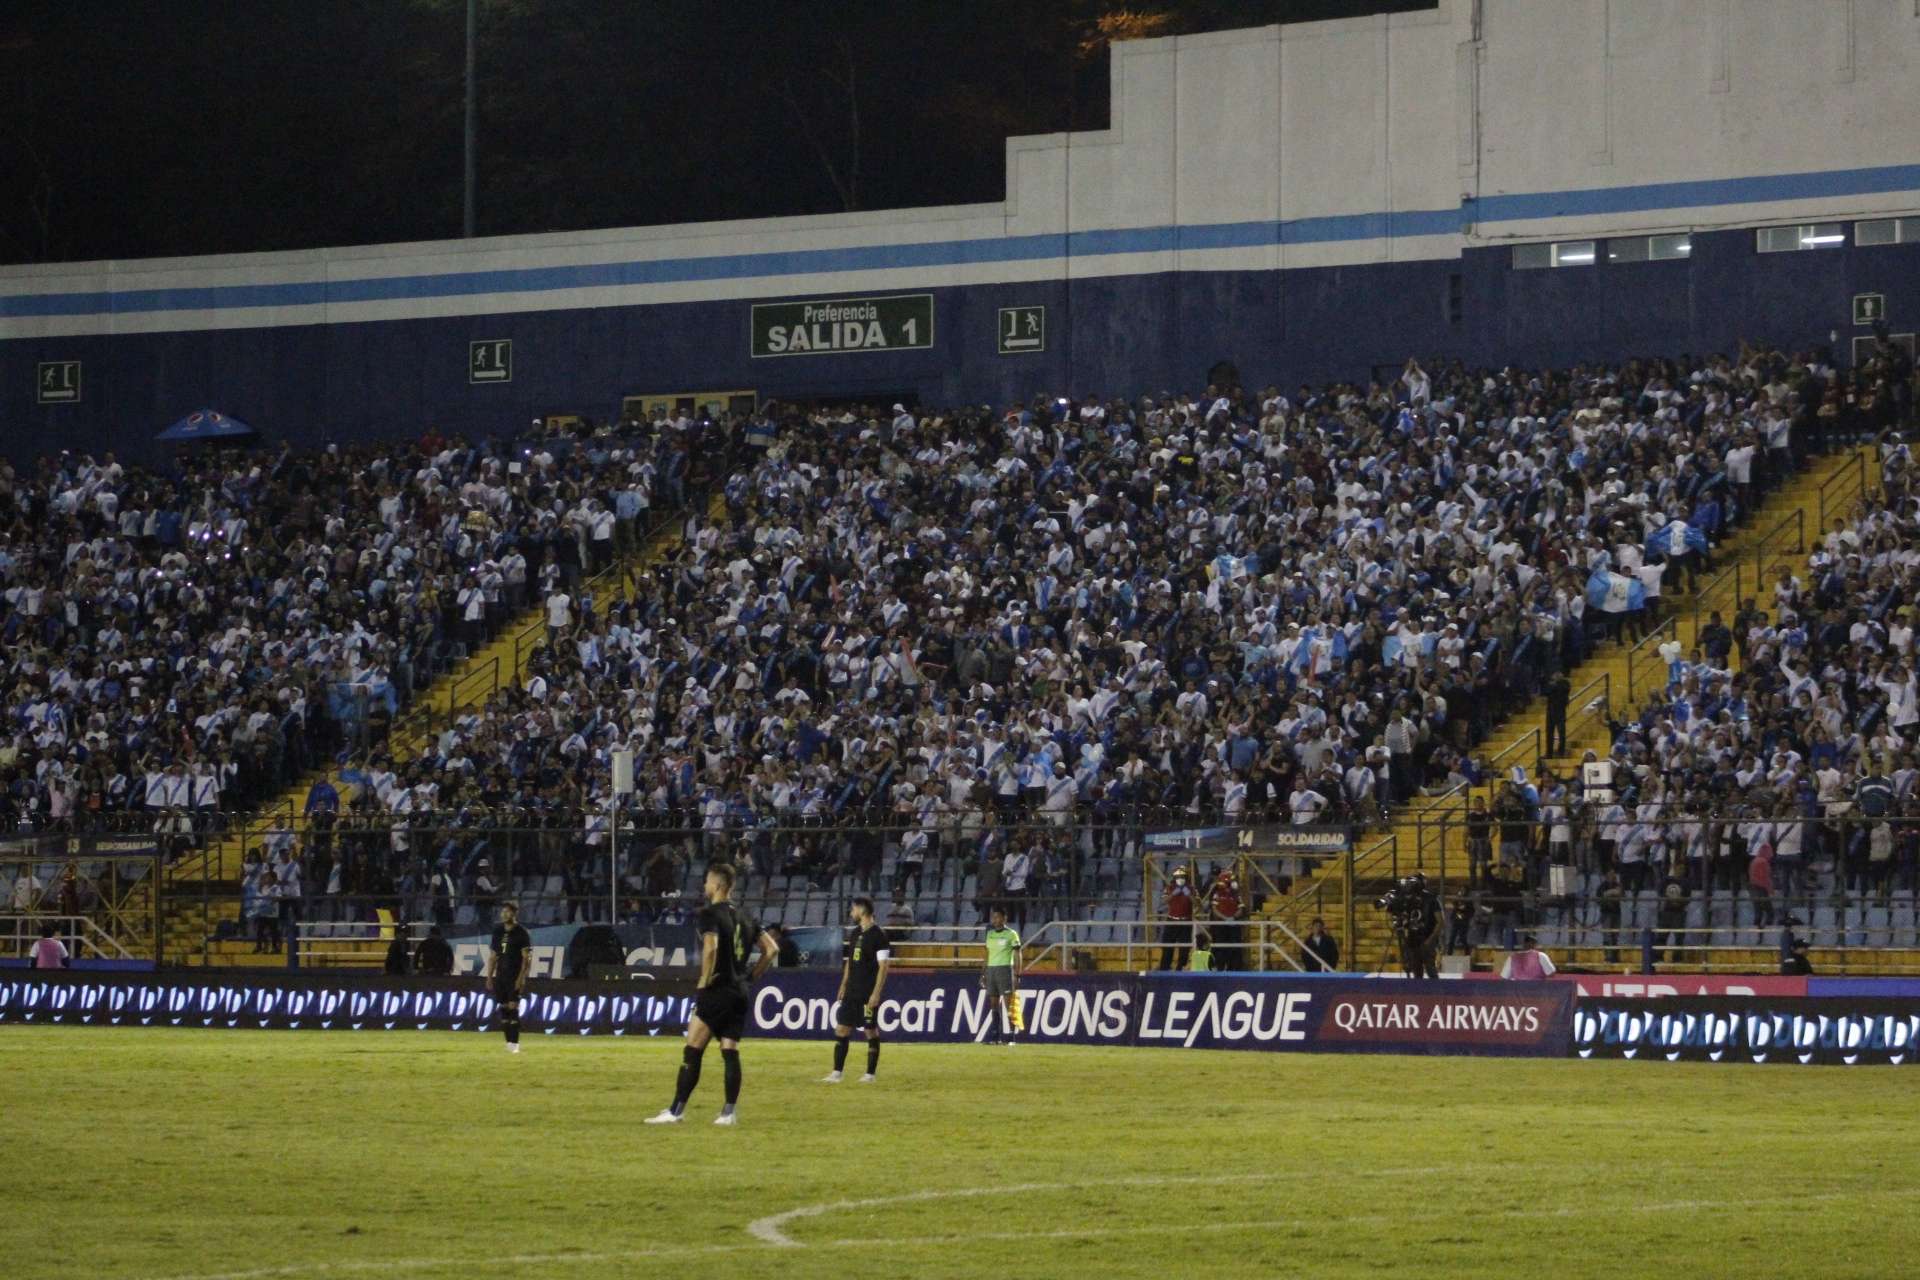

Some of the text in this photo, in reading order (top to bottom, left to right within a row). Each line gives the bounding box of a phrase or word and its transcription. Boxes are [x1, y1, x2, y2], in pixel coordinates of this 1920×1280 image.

[804, 303, 877, 323] Preferencia
[768, 318, 917, 352] SALIDA 1
[1238, 830, 1253, 847] 14
[1277, 833, 1345, 846] SOLIDARIDAD
[754, 985, 1312, 1048] Conccaf NATIONS LEAGUE
[1334, 1002, 1539, 1033] QATAR AIRWAYS
